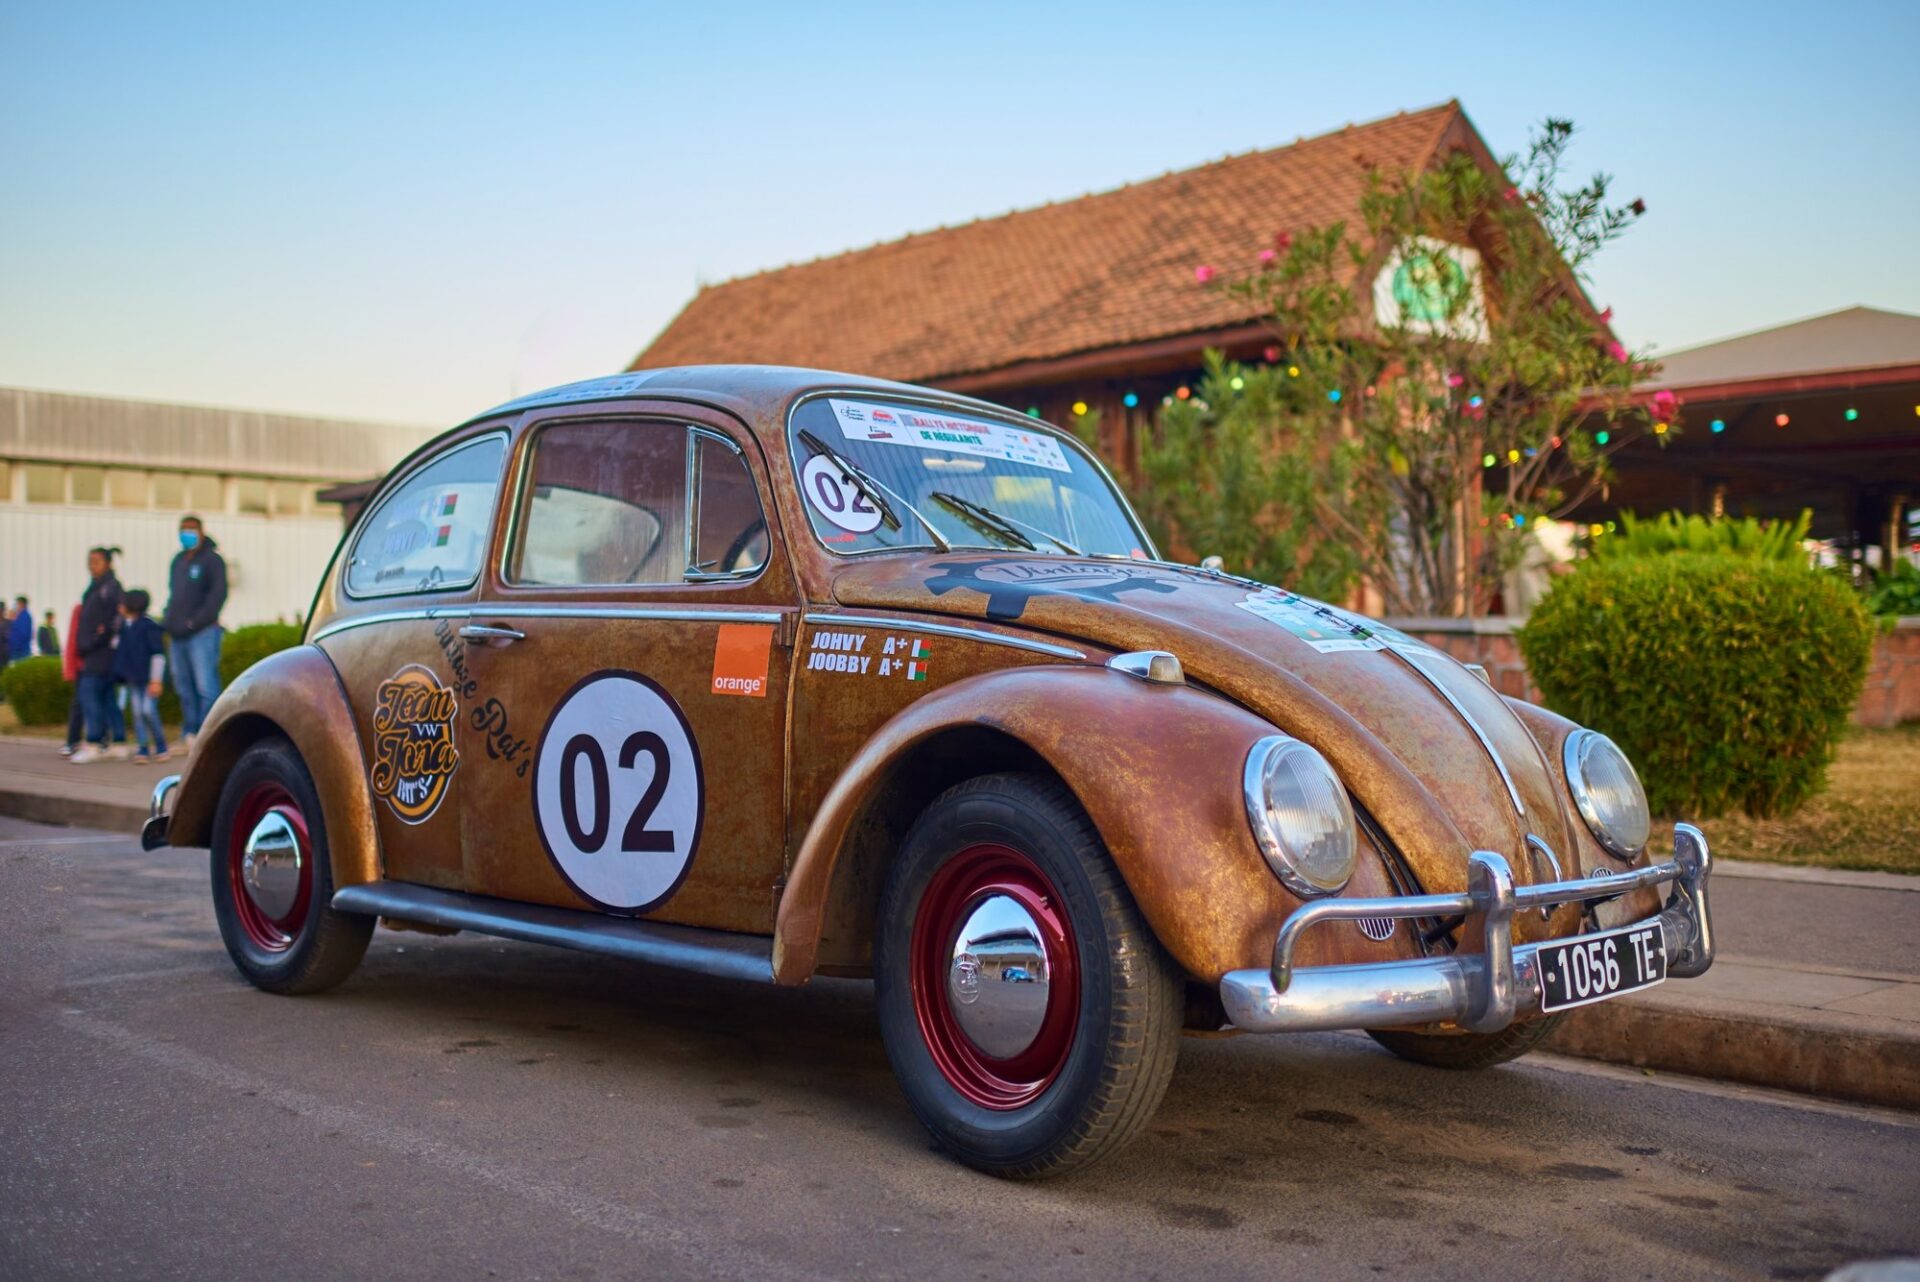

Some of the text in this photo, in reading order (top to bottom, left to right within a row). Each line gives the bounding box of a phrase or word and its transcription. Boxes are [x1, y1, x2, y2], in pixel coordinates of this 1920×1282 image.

[914, 417, 946, 430] RALLYE
[920, 430, 933, 440] DE
[815, 471, 875, 514] 02
[811, 632, 866, 651] JOHVY
[807, 652, 870, 674] JOOBBY
[715, 675, 760, 694] orange
[374, 679, 455, 731] Team
[415, 723, 438, 737] VW
[471, 698, 531, 778] Rat's
[560, 731, 675, 854] 02
[1558, 930, 1657, 1000] 1056 TE
